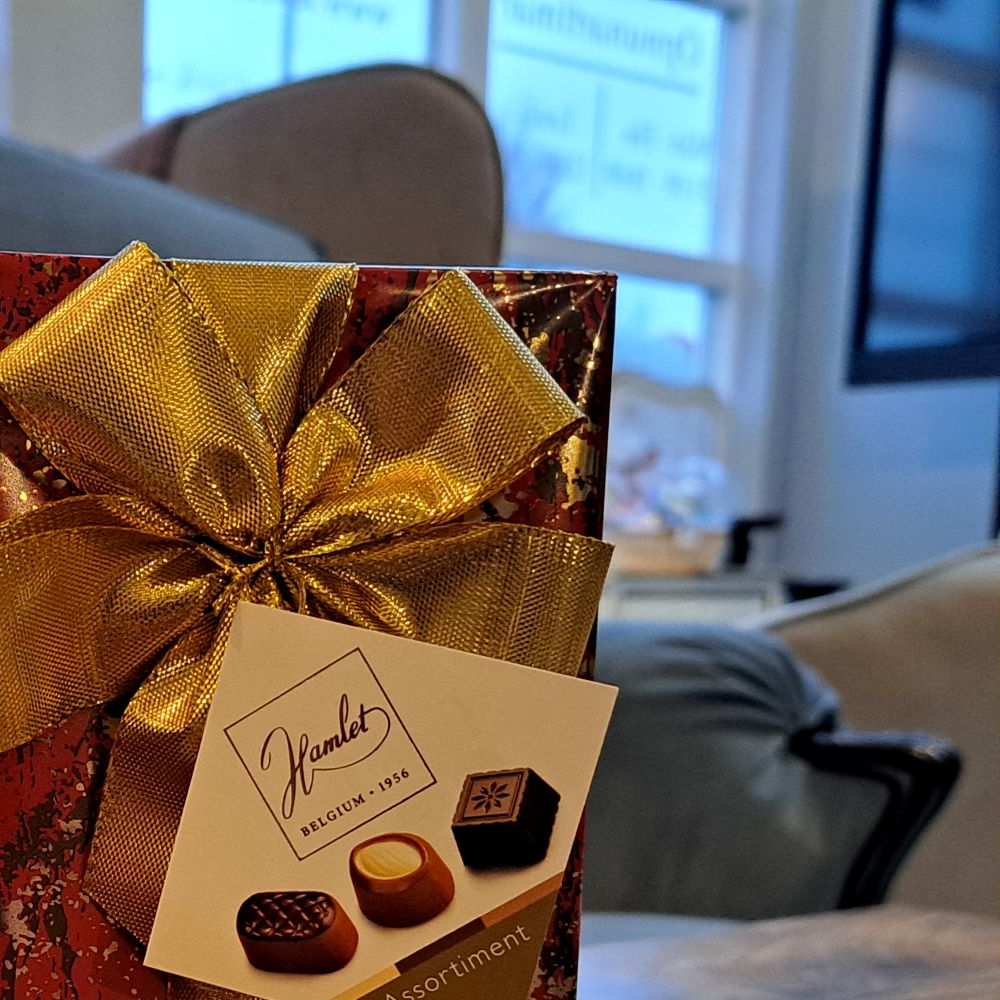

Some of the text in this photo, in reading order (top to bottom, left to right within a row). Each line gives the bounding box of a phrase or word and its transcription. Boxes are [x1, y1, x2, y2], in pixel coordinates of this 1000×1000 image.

[260, 693, 391, 820] Hamlet
[300, 768, 411, 838] BELGIUM 1956
